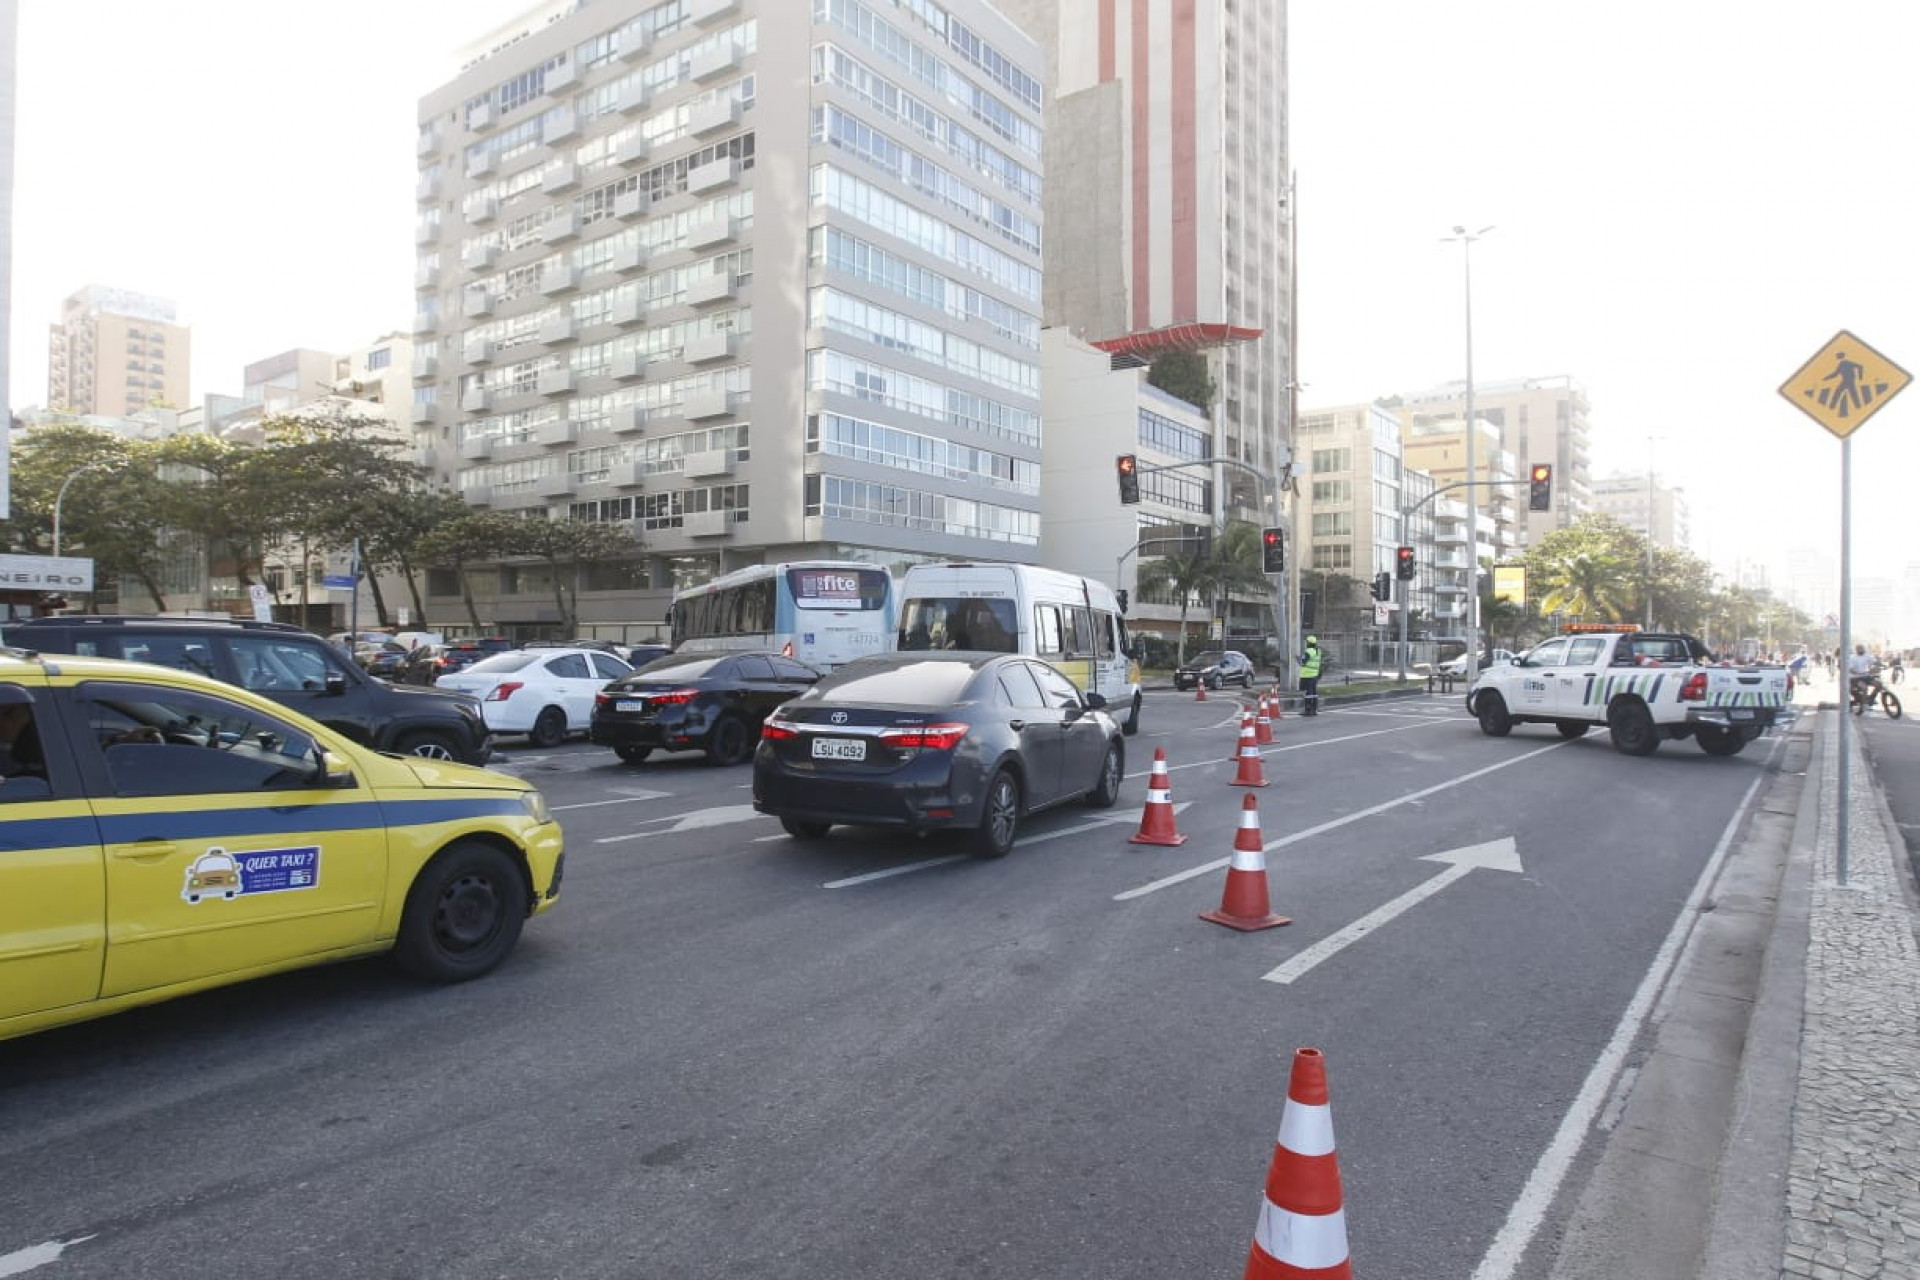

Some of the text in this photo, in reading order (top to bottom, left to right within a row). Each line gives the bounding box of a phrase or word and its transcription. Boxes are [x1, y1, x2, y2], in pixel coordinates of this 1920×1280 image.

[0, 574, 83, 585] NEIRO
[246, 856, 278, 872] QUER
[281, 854, 305, 867] TAXI
